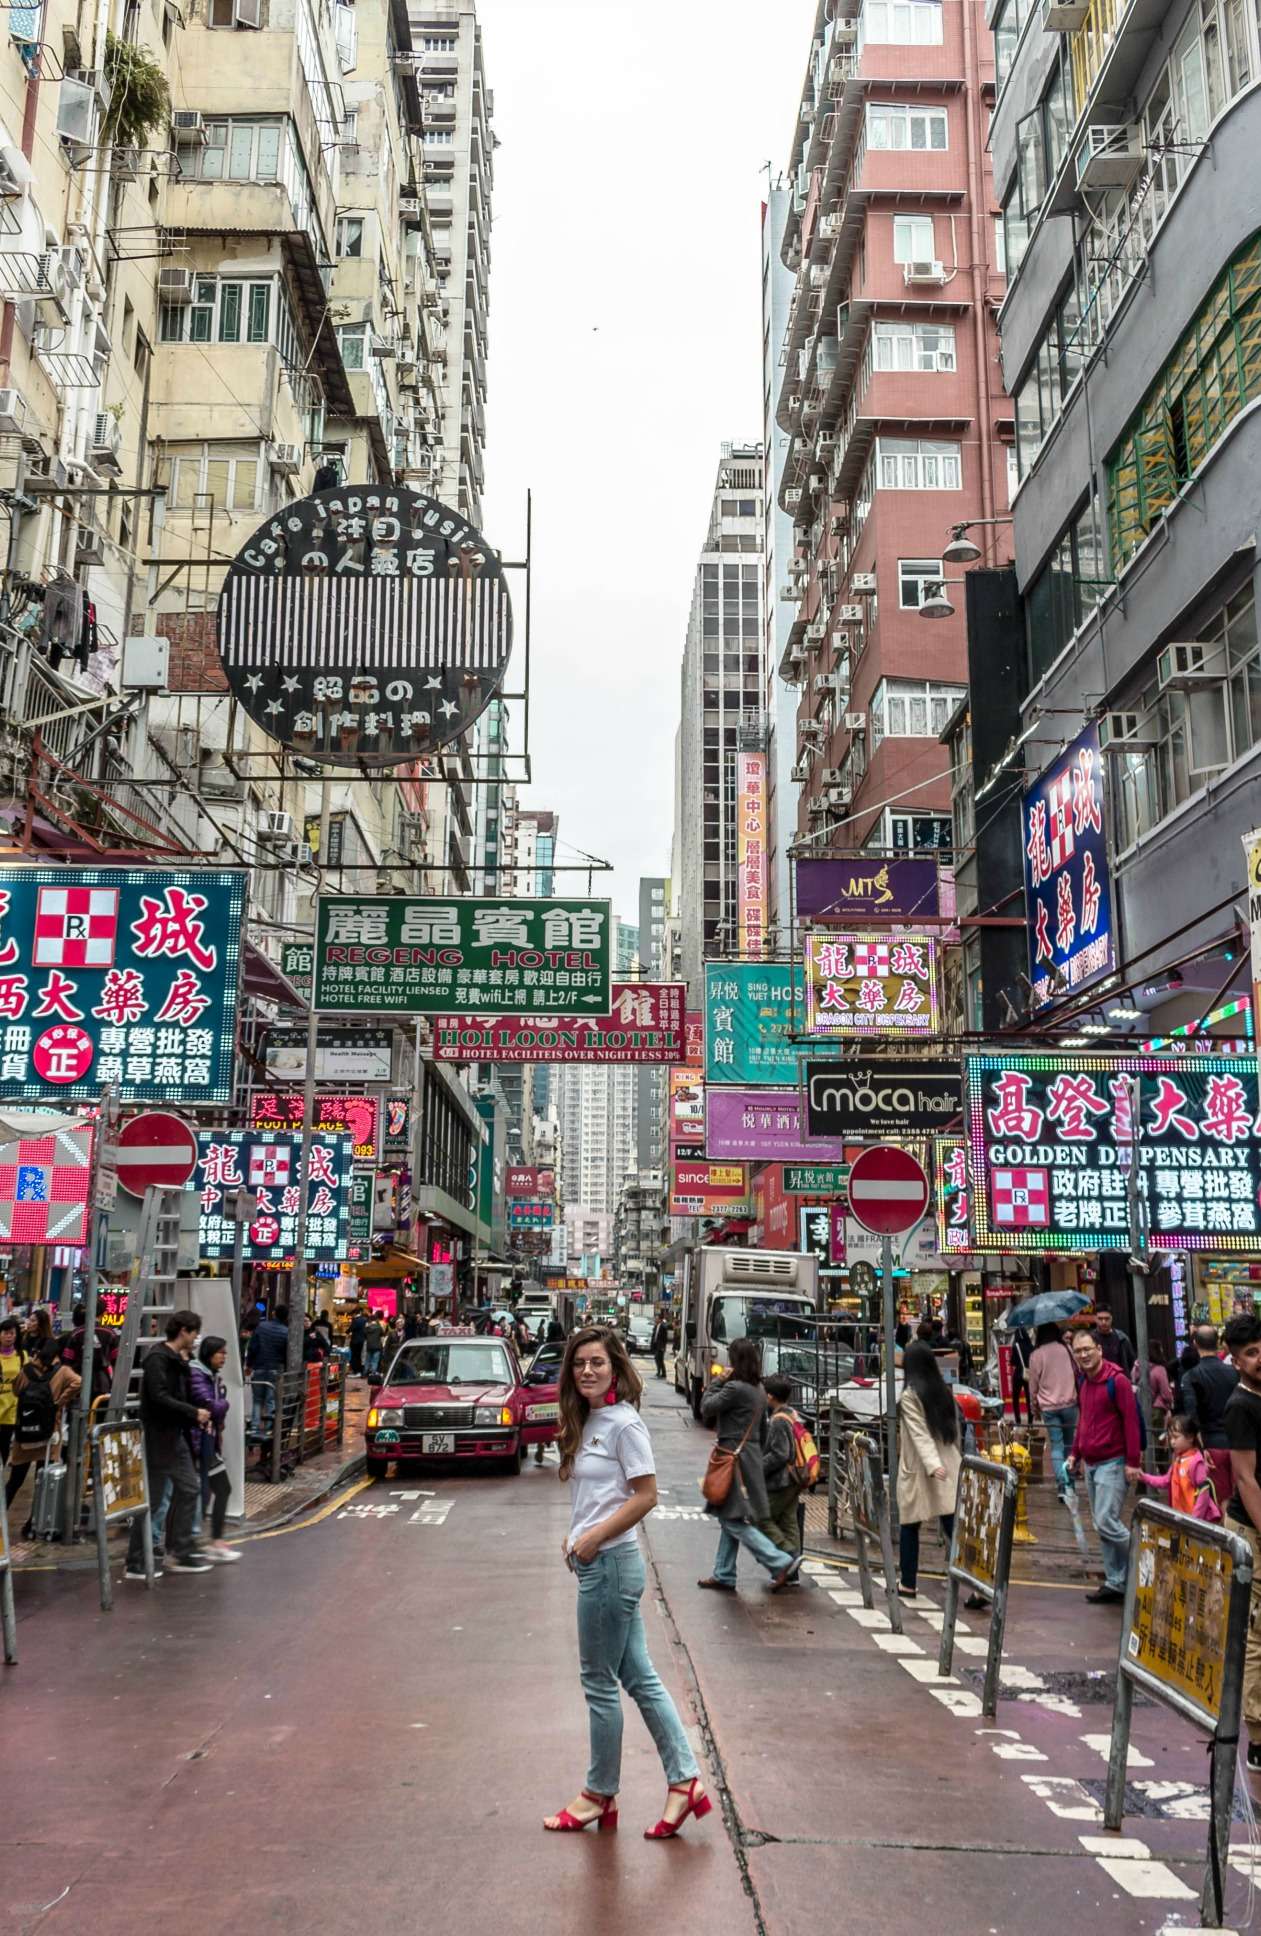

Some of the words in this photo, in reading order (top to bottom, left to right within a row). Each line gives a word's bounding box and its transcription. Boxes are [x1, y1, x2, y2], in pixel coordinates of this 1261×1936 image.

[131, 886, 217, 970] 城
[325, 904, 605, 950] 麗晶賓館
[326, 946, 464, 966] REGENG
[491, 950, 600, 969] HOTEL
[814, 943, 855, 979] 龍
[890, 943, 930, 980] 城
[322, 966, 385, 983] 持牌賓館
[389, 968, 452, 984] 酒店設備
[456, 969, 519, 985] 豪華套房
[523, 970, 602, 987] 歡迎自由行
[747, 982, 769, 991] SING
[321, 985, 355, 994] HOTEL
[358, 985, 403, 995] FACILITY
[406, 986, 449, 996] LIENSED
[321, 994, 355, 1003] HOTEL
[358, 995, 386, 1003] FREE
[388, 995, 408, 1004] WIFI
[819, 979, 926, 1013] 大藥房
[815, 1013, 853, 1027] DRAGON
[854, 1013, 875, 1027] CITY
[876, 1013, 930, 1028] DISPENSARY
[98, 1026, 214, 1056] 專營批發
[438, 1029, 494, 1047] HOI
[498, 1030, 578, 1048] LOON
[583, 1031, 681, 1049] HOTEL
[45, 1048, 79, 1077] 正
[462, 1049, 500, 1058] HOTEL
[502, 1049, 563, 1059] FACILITEIS
[566, 1050, 595, 1059] OVER
[597, 1050, 633, 1060] NIGHT
[635, 1051, 661, 1060] LESS
[822, 1088, 915, 1112] moca
[918, 1092, 957, 1112] hair
[199, 1143, 244, 1185] 龍
[989, 1144, 1088, 1165] GOLDEN
[1098, 1146, 1249, 1167] DIPENSARY
[1154, 1170, 1253, 1200] 專營批發
[199, 1184, 338, 1218] 中大藥房
[1157, 1201, 1256, 1232] 參茸燕窩
